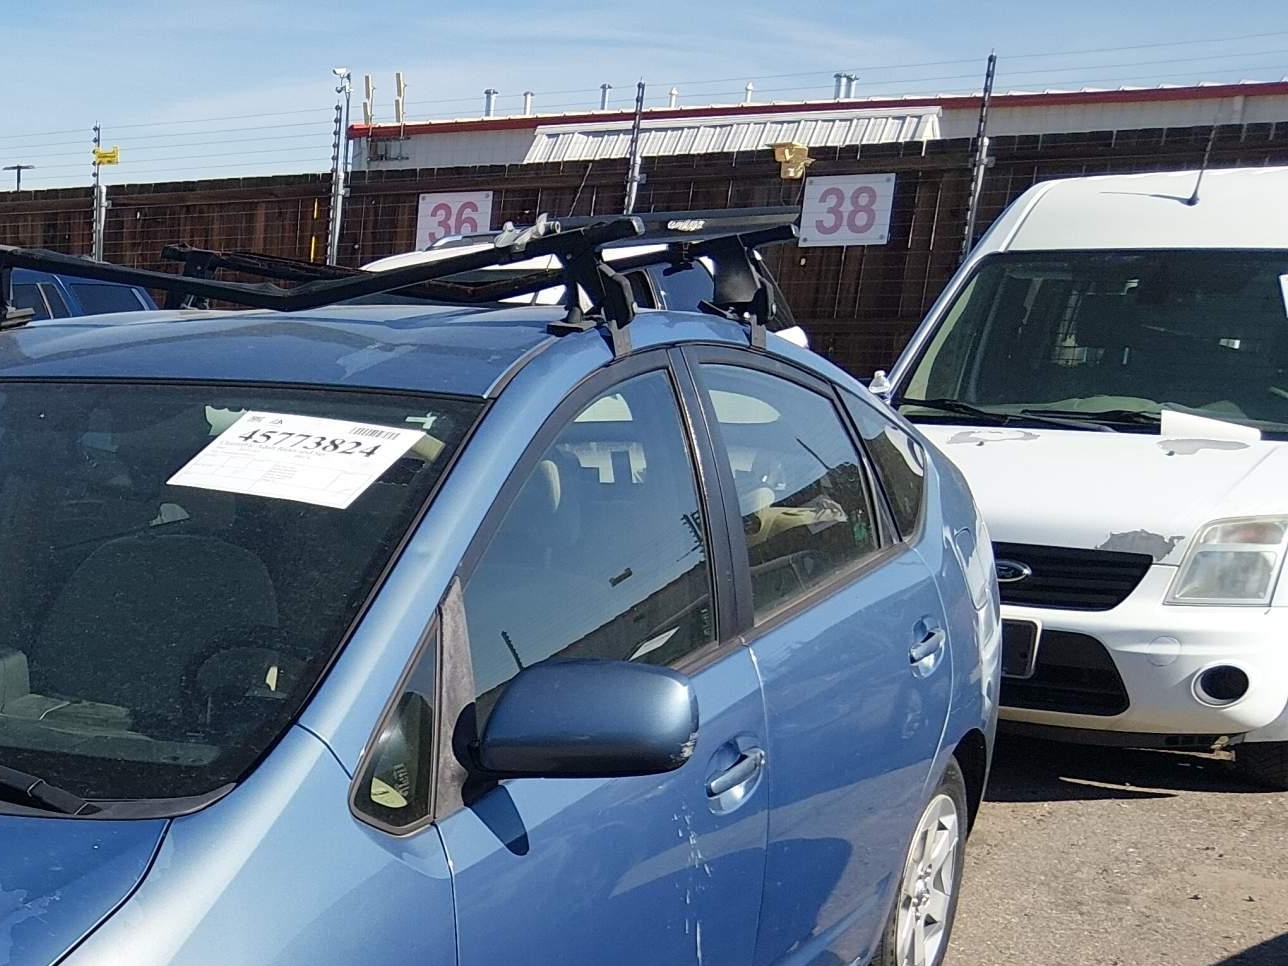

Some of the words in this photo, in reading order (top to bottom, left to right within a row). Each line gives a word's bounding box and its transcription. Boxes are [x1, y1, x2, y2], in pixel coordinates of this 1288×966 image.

[428, 201, 479, 242] 36
[815, 186, 877, 235] 38
[238, 428, 382, 458] 45773824
